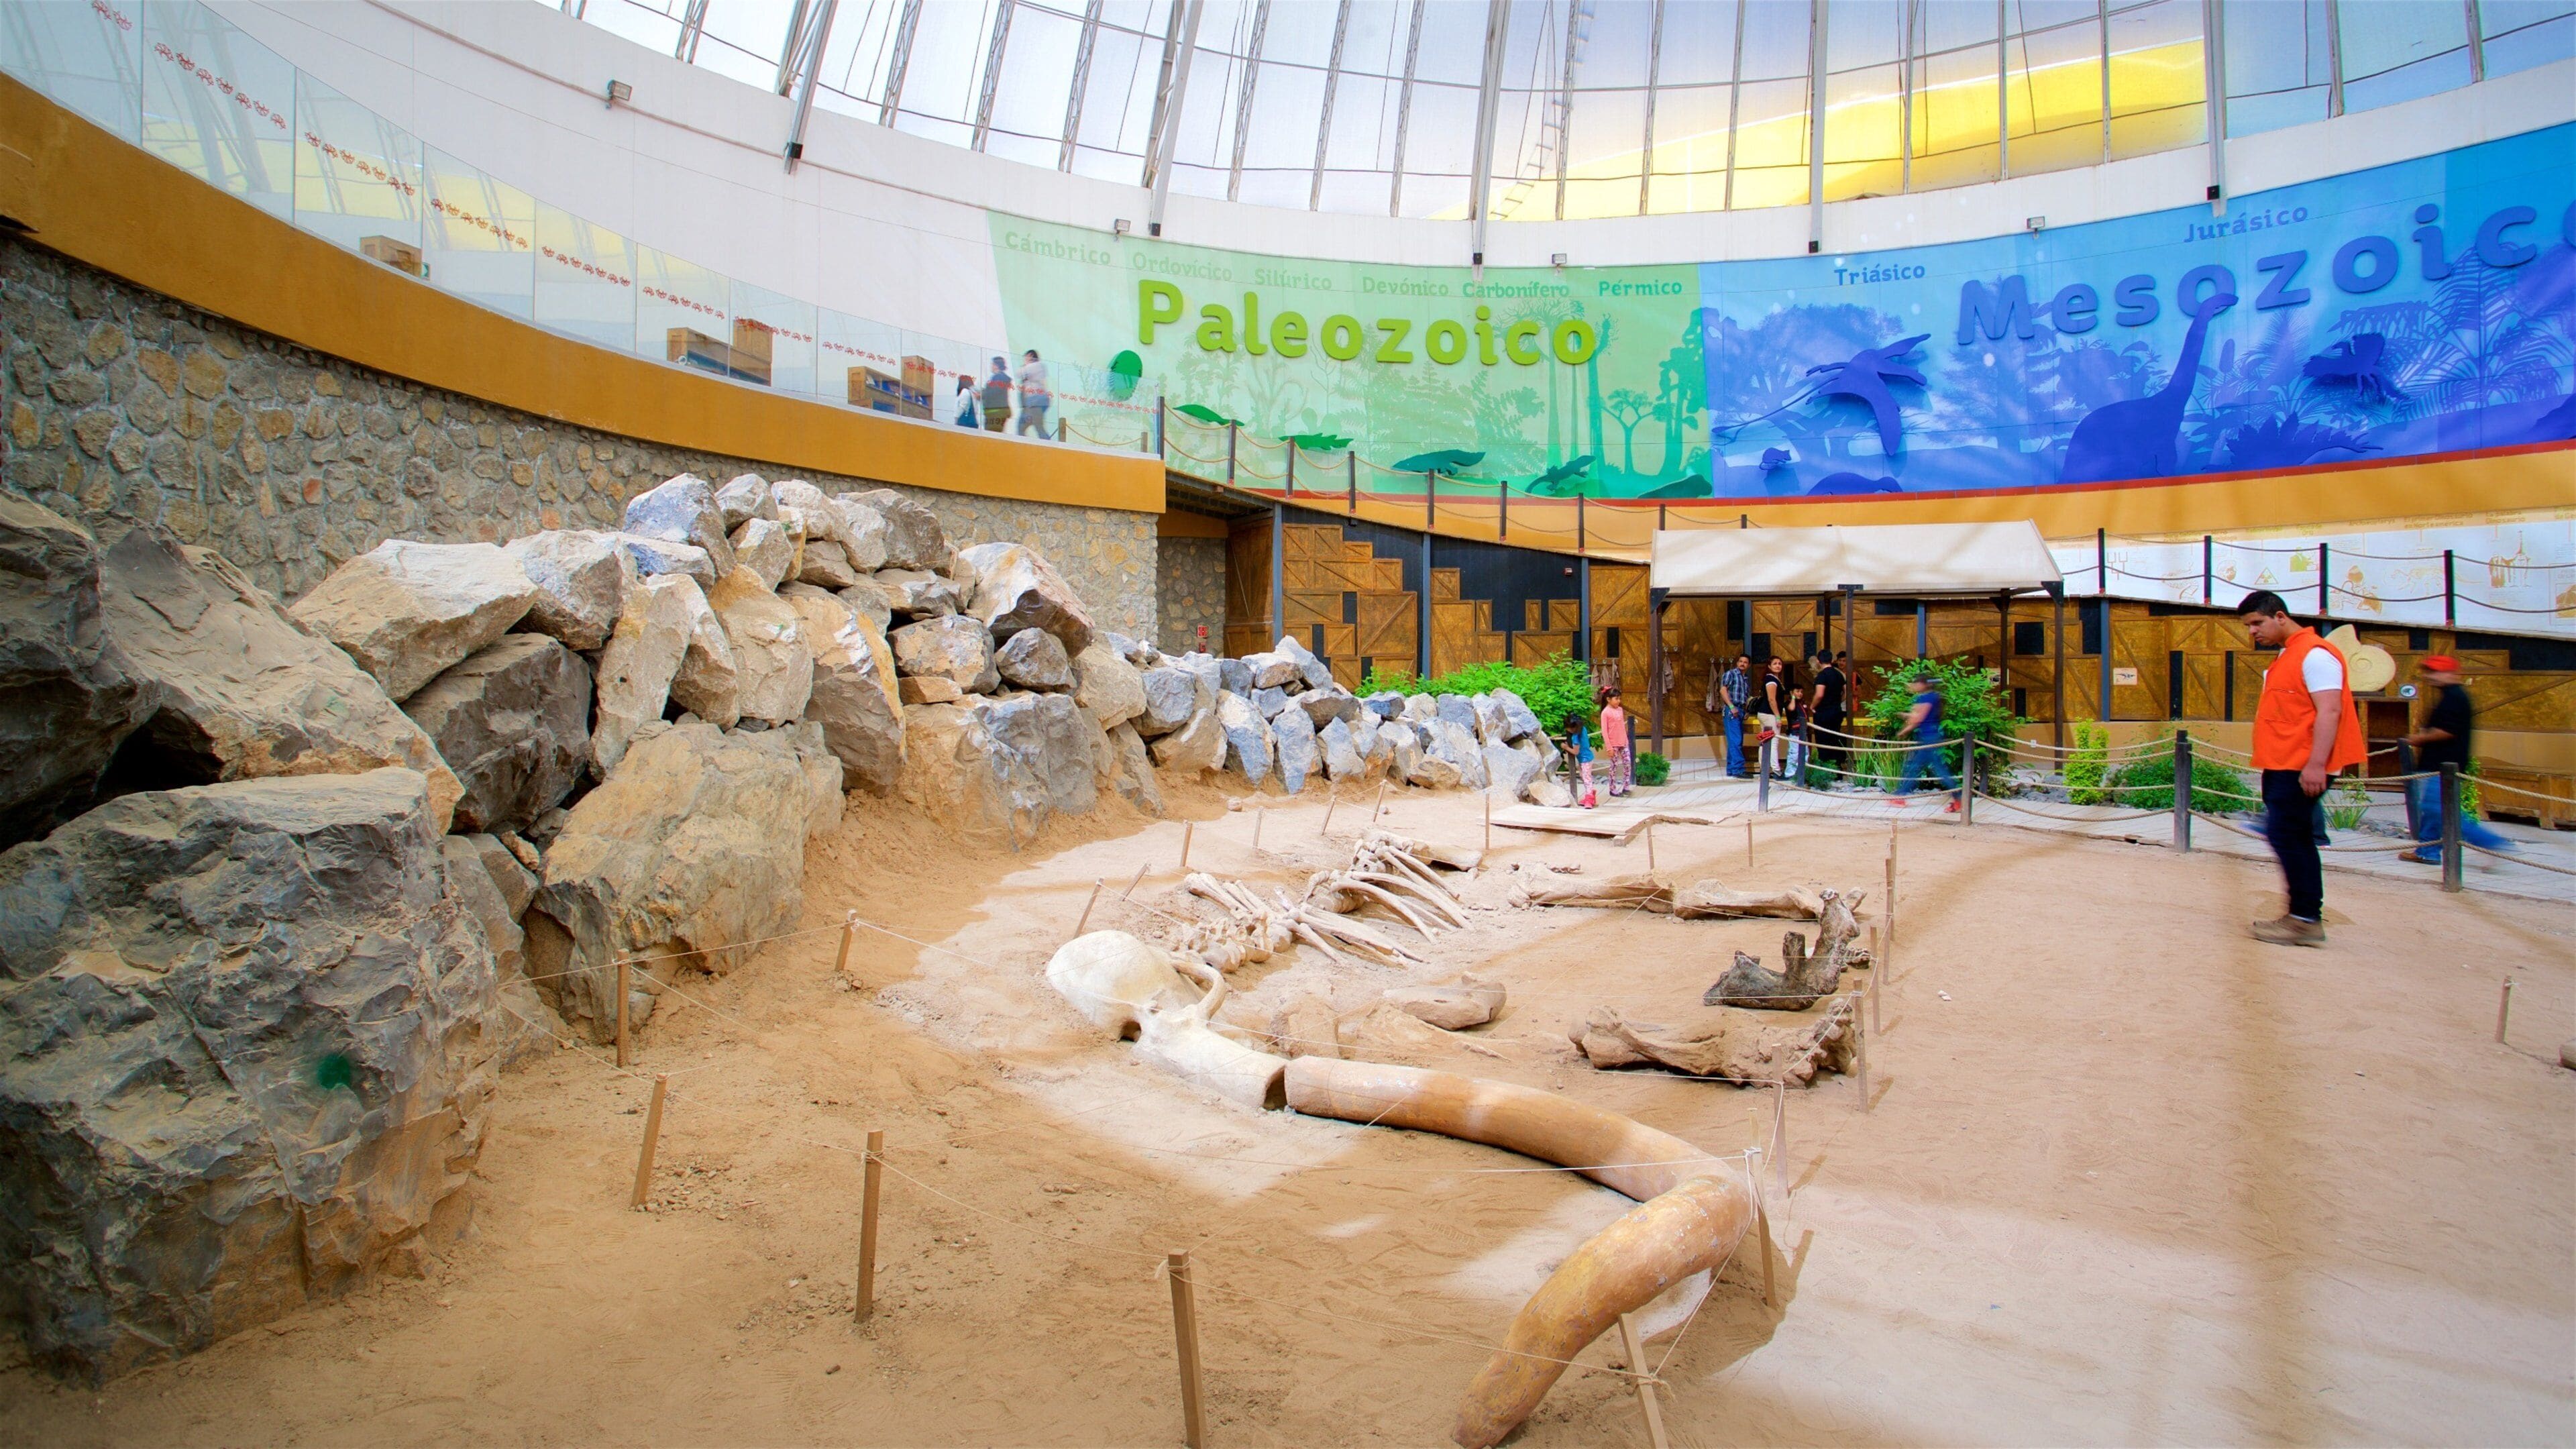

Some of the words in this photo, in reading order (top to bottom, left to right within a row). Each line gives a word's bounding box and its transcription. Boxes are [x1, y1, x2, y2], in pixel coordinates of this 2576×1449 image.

[2183, 207, 2308, 242] Jurásico
[1005, 231, 1111, 266] Cámbrico
[1133, 252, 1233, 282] Ordovícico
[1254, 268, 1332, 290] Silúrico
[1362, 276, 1450, 297] Devónico
[1462, 280, 1570, 298] Carbonífero
[1599, 278, 1682, 296] Pérmico
[1834, 263, 1925, 286] Triásico
[1957, 199, 2576, 345] Mesozoic
[1139, 279, 1595, 366] Paleozoico
